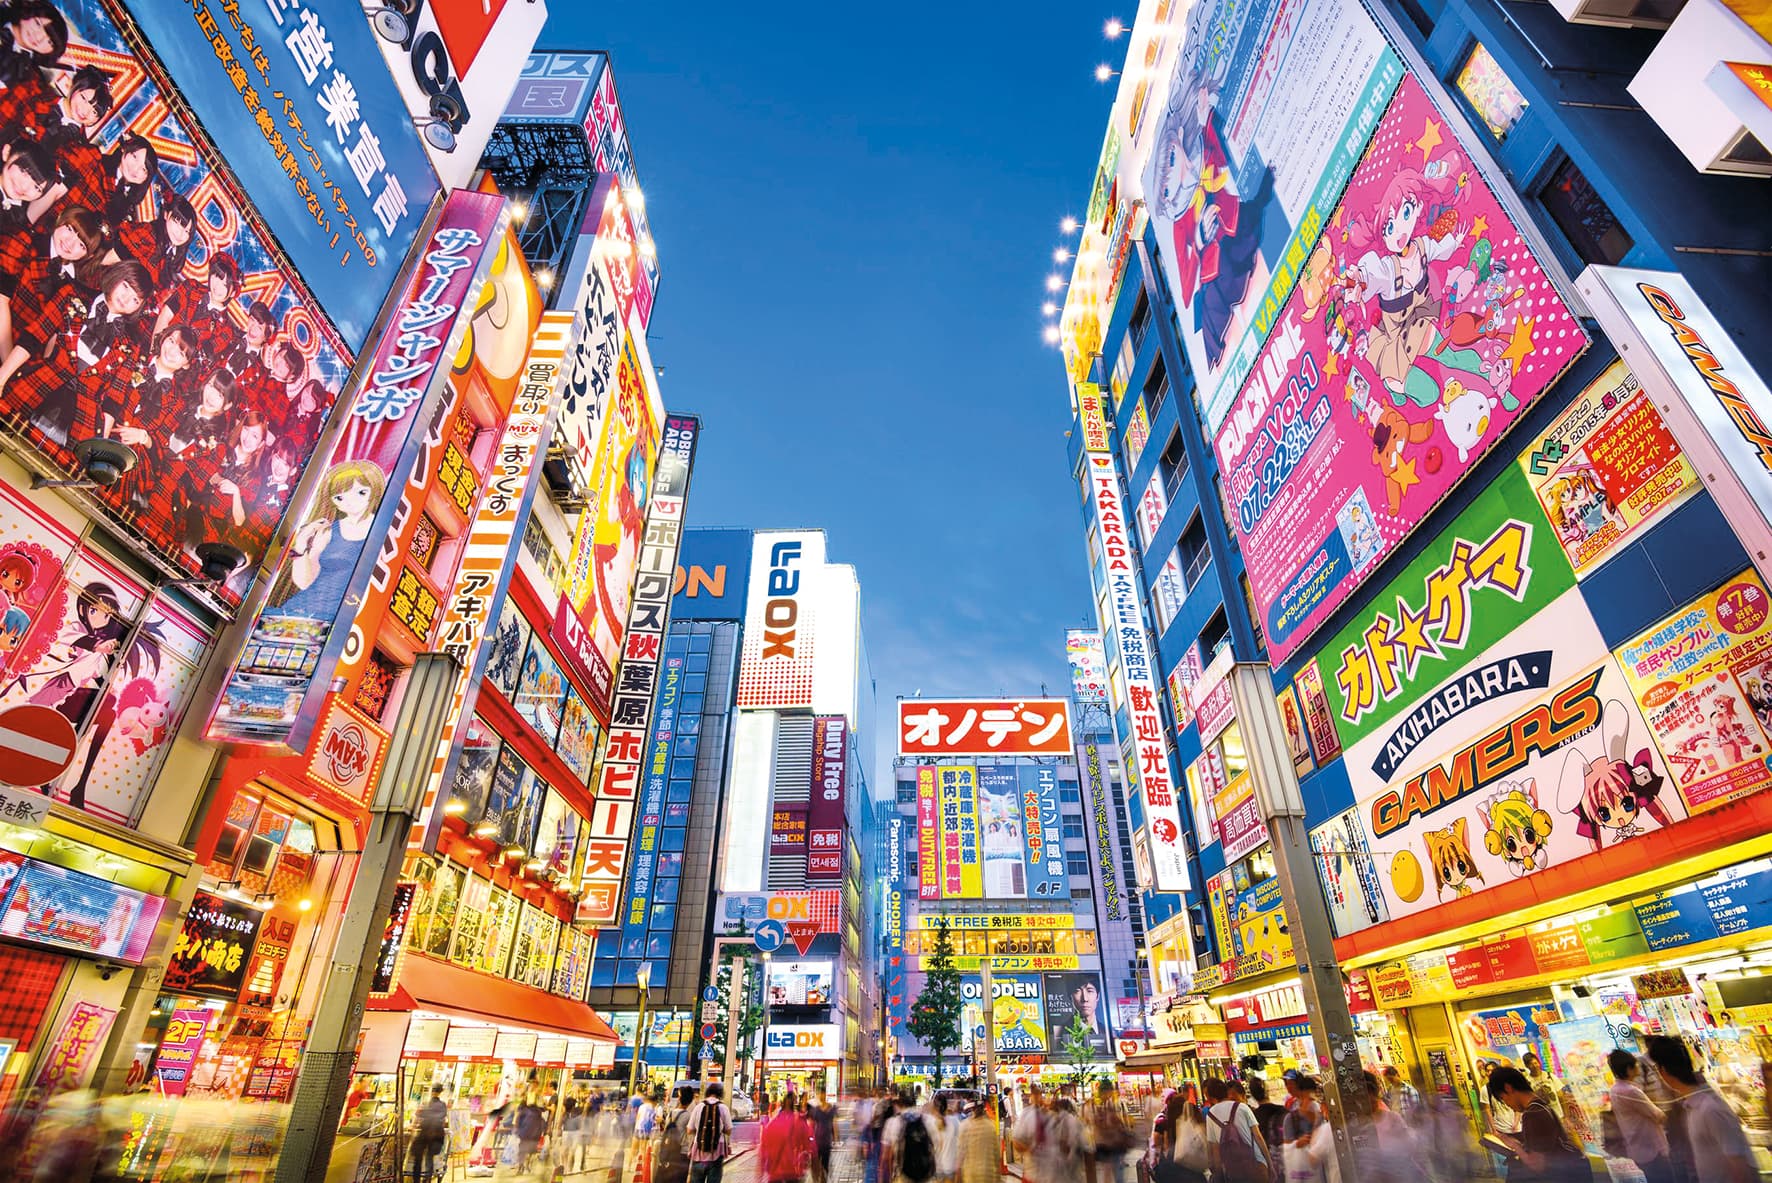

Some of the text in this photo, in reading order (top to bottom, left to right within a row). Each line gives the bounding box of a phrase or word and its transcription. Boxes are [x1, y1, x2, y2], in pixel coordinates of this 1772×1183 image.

[354, 228, 482, 423] サマージャンボ
[518, 364, 556, 415] 買取り
[1267, 352, 1320, 444] Vol.1
[1613, 432, 1656, 471] オリジナル
[1620, 443, 1662, 483] ブロマイド
[488, 444, 530, 516] まっくす
[1240, 443, 1292, 532] 07.22
[1095, 478, 1129, 570] TAKARADA
[1560, 491, 1606, 533] SAMPLE
[1717, 585, 1761, 619] 第7巻
[1121, 627, 1149, 681] 免税商店
[904, 702, 1064, 747] オノデン
[1386, 658, 1528, 769] AKIHABARA
[1371, 665, 1606, 839] GAMERS
[1558, 723, 1596, 749] ANIBRO
[823, 720, 845, 801] Duty Free
[812, 832, 839, 846] 免税
[890, 819, 901, 883] Panasonic
[1036, 882, 1061, 895] 4F
[262, 917, 296, 944] 入口
[794, 928, 815, 936] 止まれ
[891, 891, 901, 948] ONODEN
[954, 916, 989, 927] FREE
[992, 958, 1030, 968] エアコン
[962, 983, 1038, 998] OODEN
[165, 1019, 206, 1045] 2F
